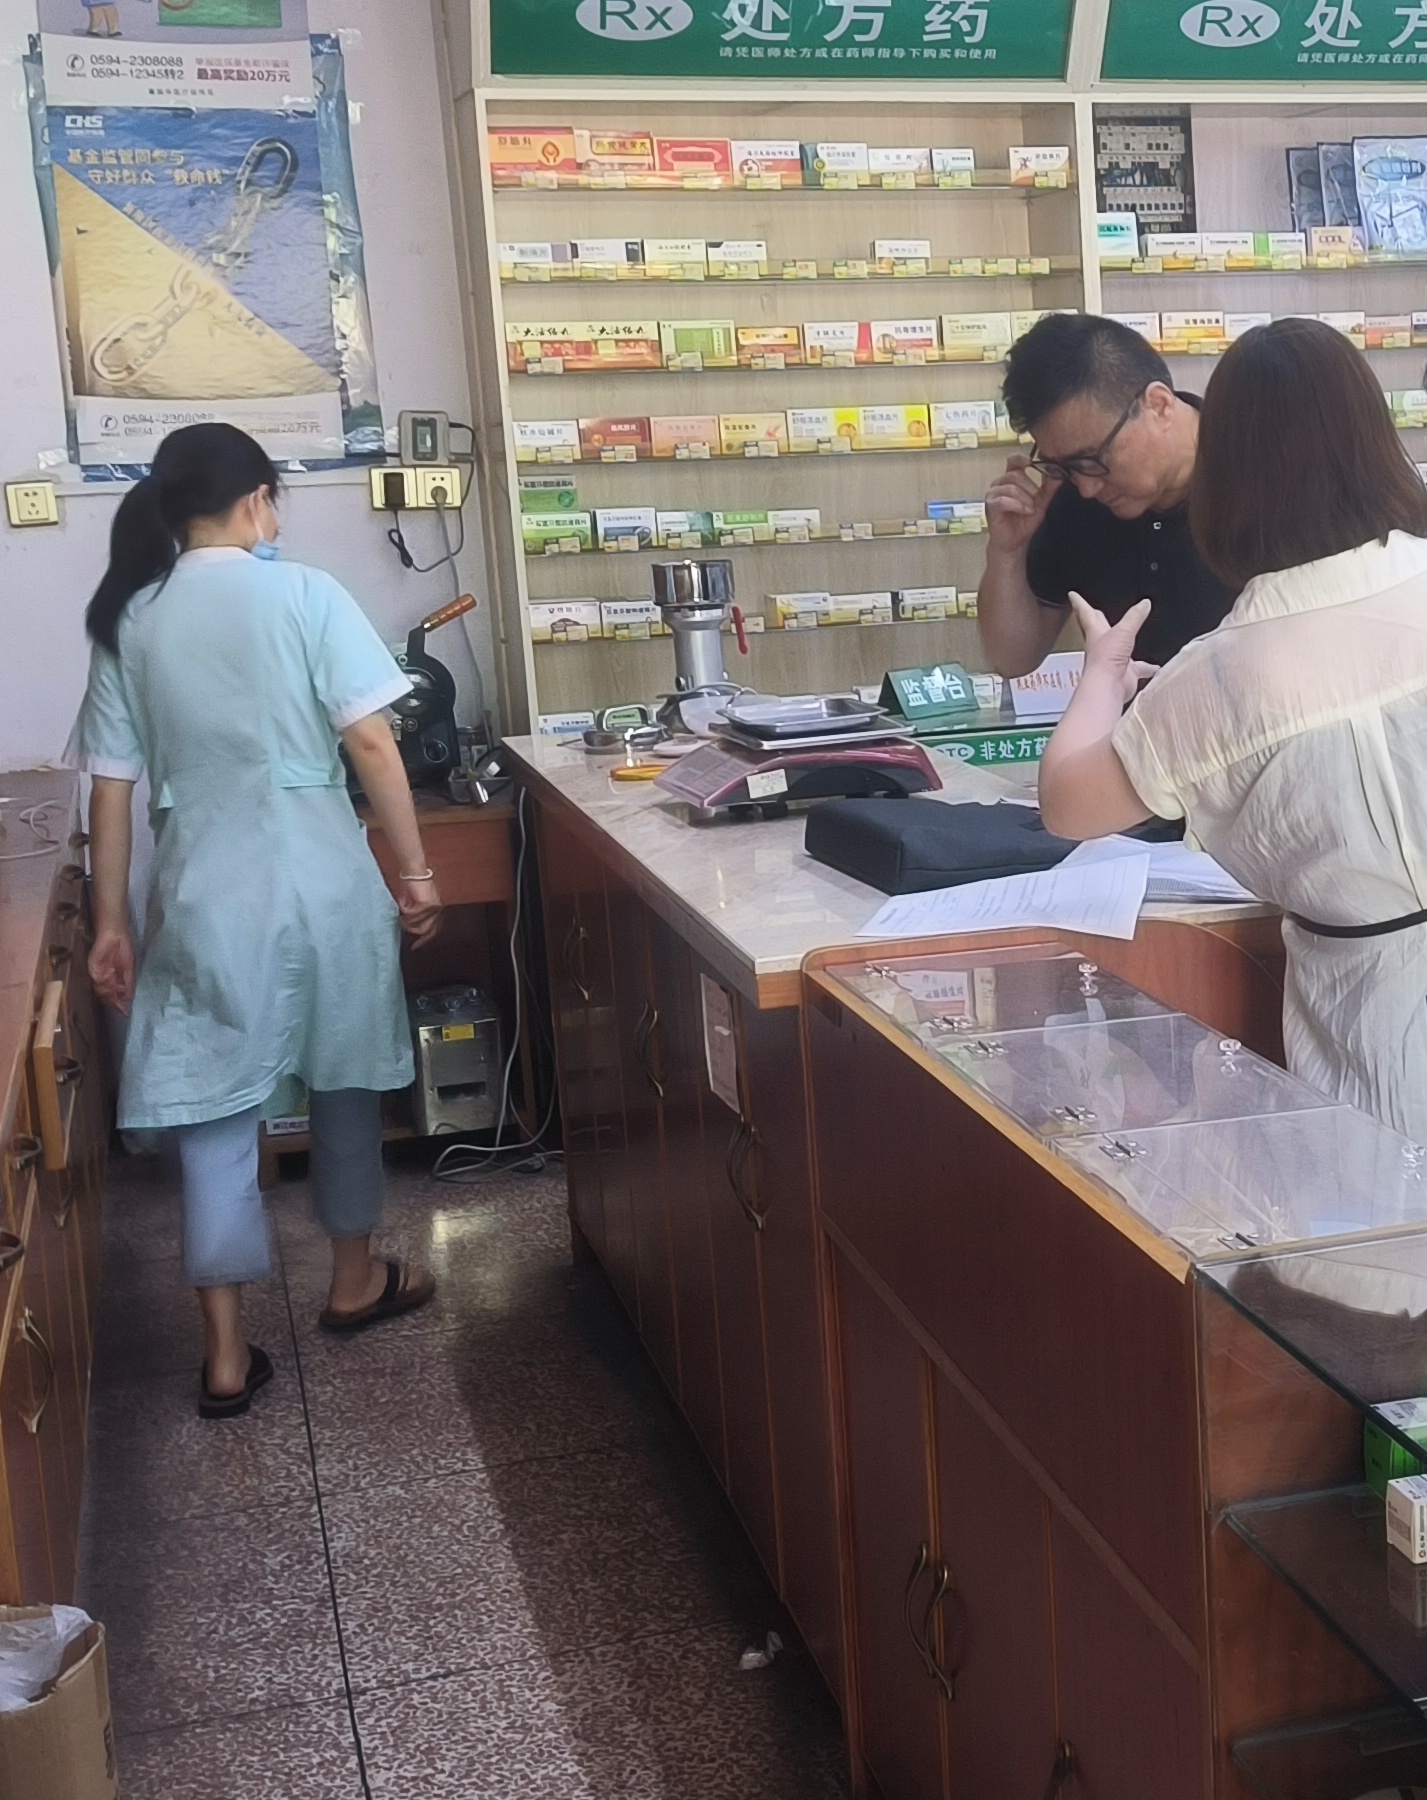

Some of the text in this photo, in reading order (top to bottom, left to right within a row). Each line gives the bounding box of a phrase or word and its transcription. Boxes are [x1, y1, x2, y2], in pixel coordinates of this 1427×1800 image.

[598, 0, 989, 43] Rx 处方药
[1198, 4, 1265, 38] Rx
[90, 55, 184, 67] 0594-2308088
[719, 45, 998, 60] 请凭医师处方或在药师指导下购买和使用
[197, 68, 292, 82] 最高奖励20万元
[901, 672, 967, 707] 监督台
